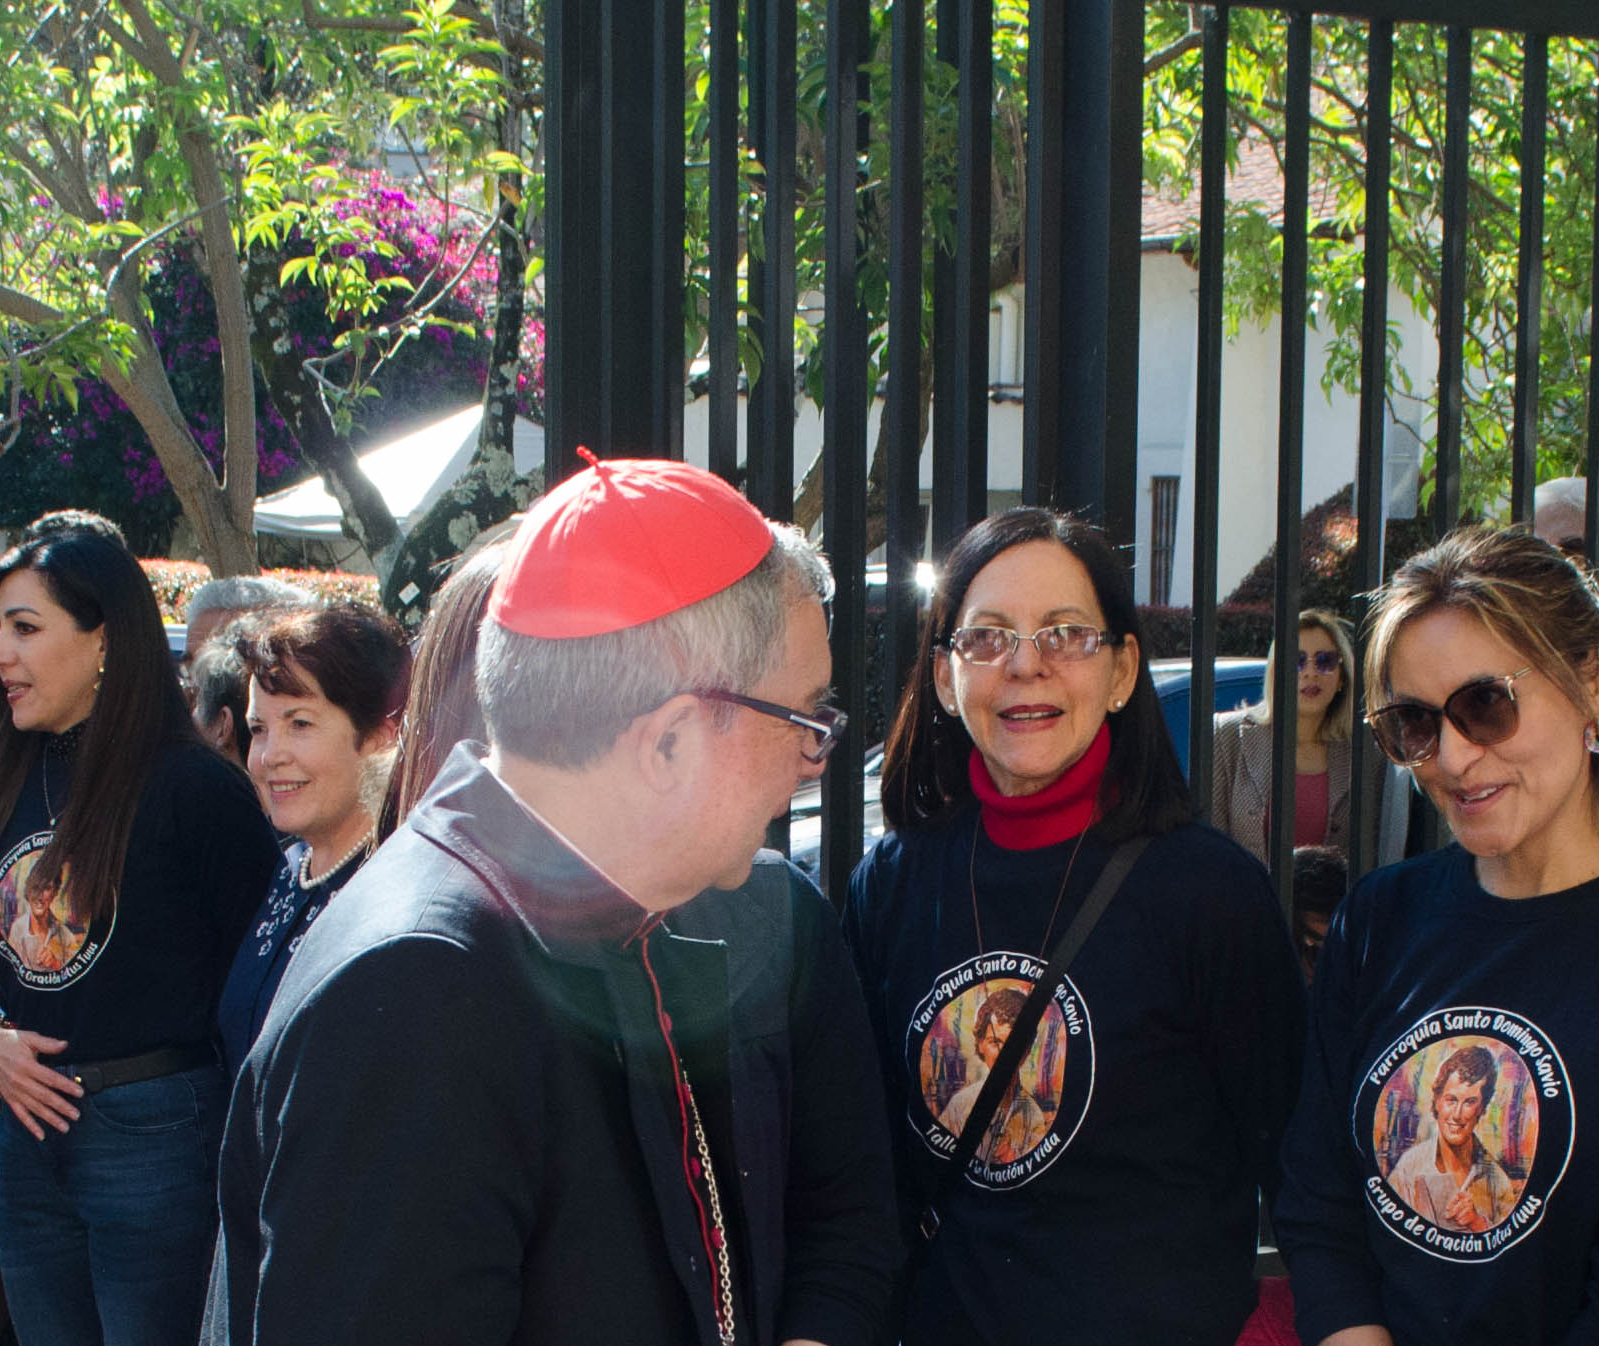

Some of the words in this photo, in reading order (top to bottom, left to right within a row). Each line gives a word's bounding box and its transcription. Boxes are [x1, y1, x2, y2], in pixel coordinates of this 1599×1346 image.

[913, 968, 974, 1033] Parroquia
[974, 954, 1017, 976] Santo
[1062, 995, 1084, 1035] Savio
[1369, 1020, 1443, 1086] Parroquia
[1443, 1010, 1491, 1031] Santo
[1492, 1014, 1544, 1058] Domingo
[1535, 1054, 1561, 1098] Savio
[983, 1162, 1024, 1182] Oración
[1025, 1158, 1033, 1173] y
[1367, 1176, 1405, 1221] Grupo
[1404, 1215, 1426, 1237] de
[1425, 1227, 1483, 1252] Oración
